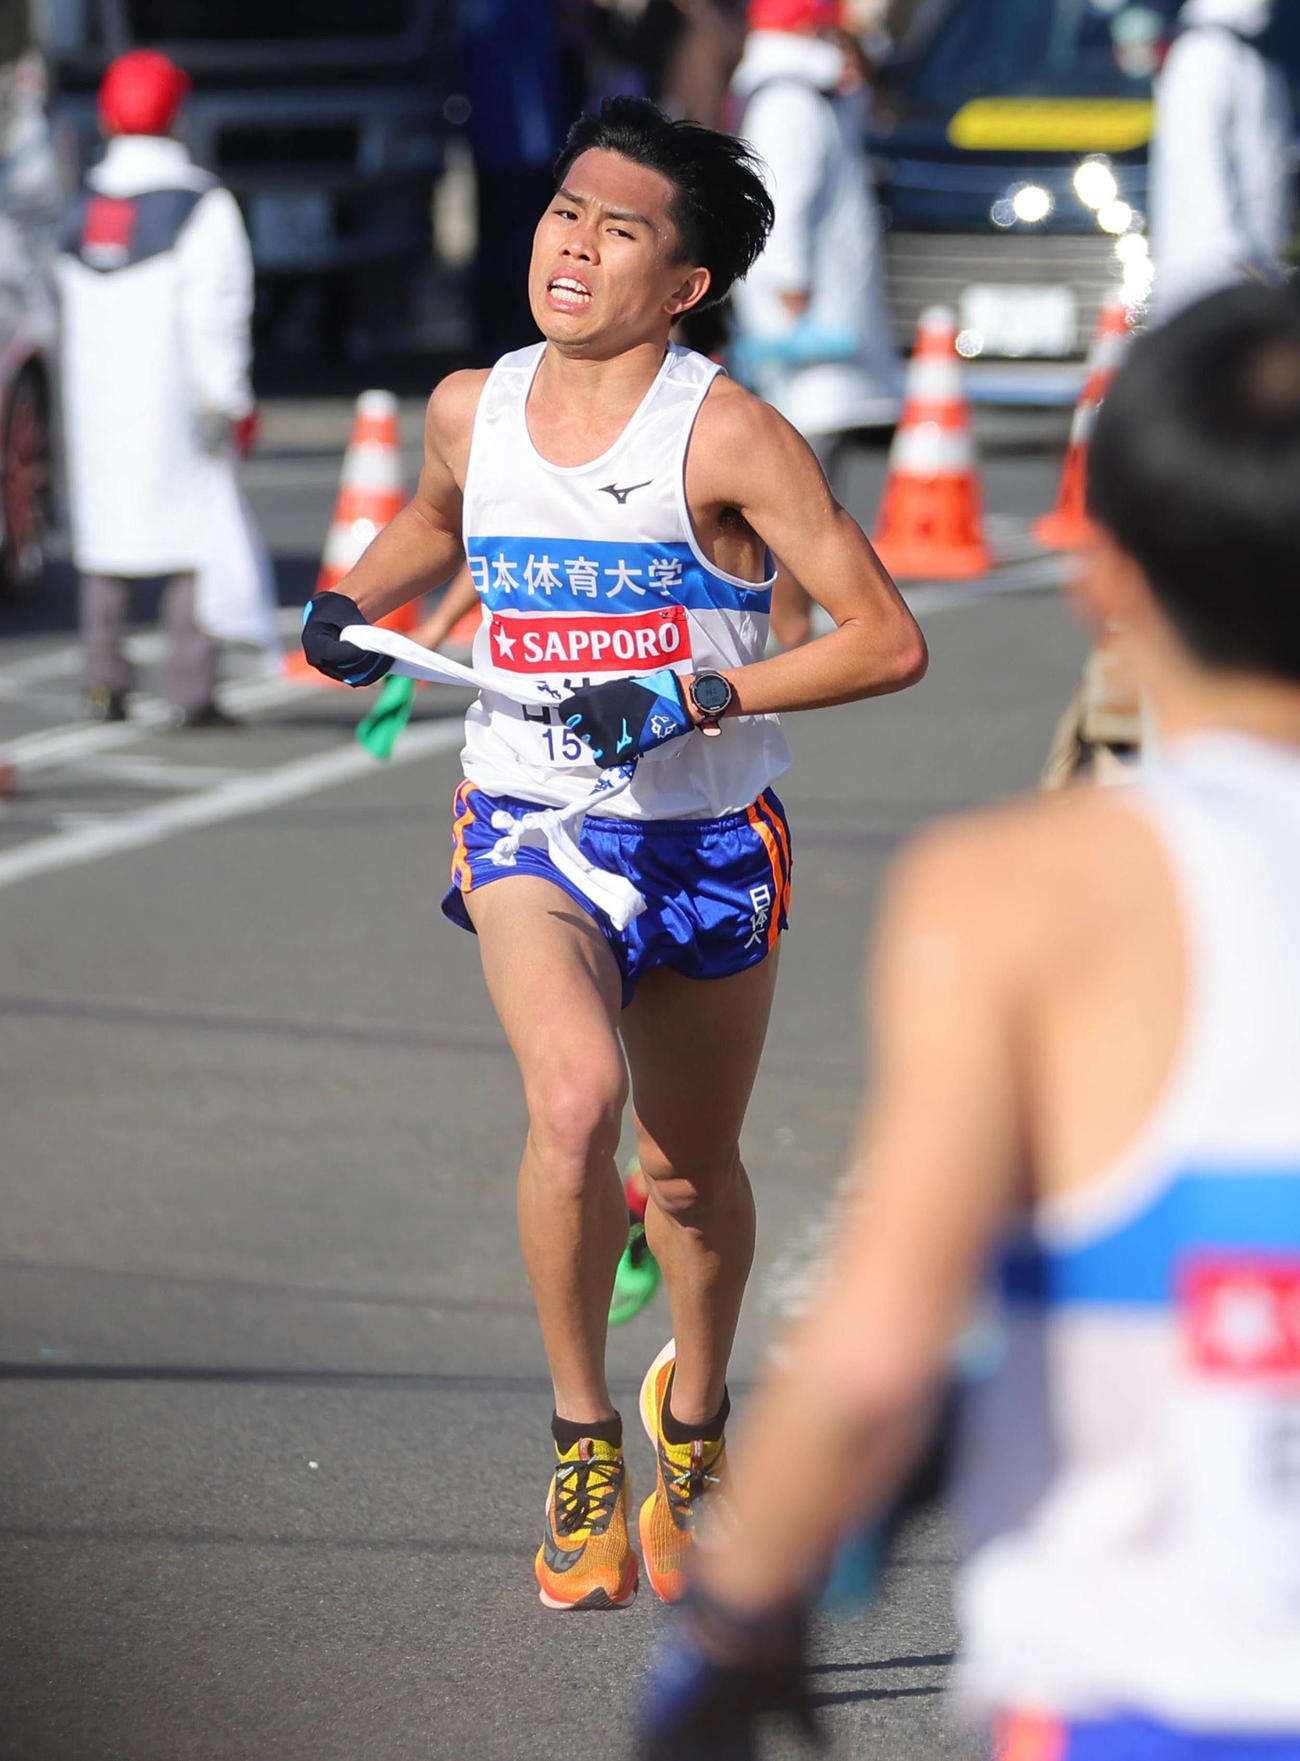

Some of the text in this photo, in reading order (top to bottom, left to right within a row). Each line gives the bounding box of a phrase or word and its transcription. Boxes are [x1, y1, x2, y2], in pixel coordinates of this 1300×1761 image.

[467, 553, 683, 598] 日本体育大学
[522, 622, 680, 663] SAPPORO
